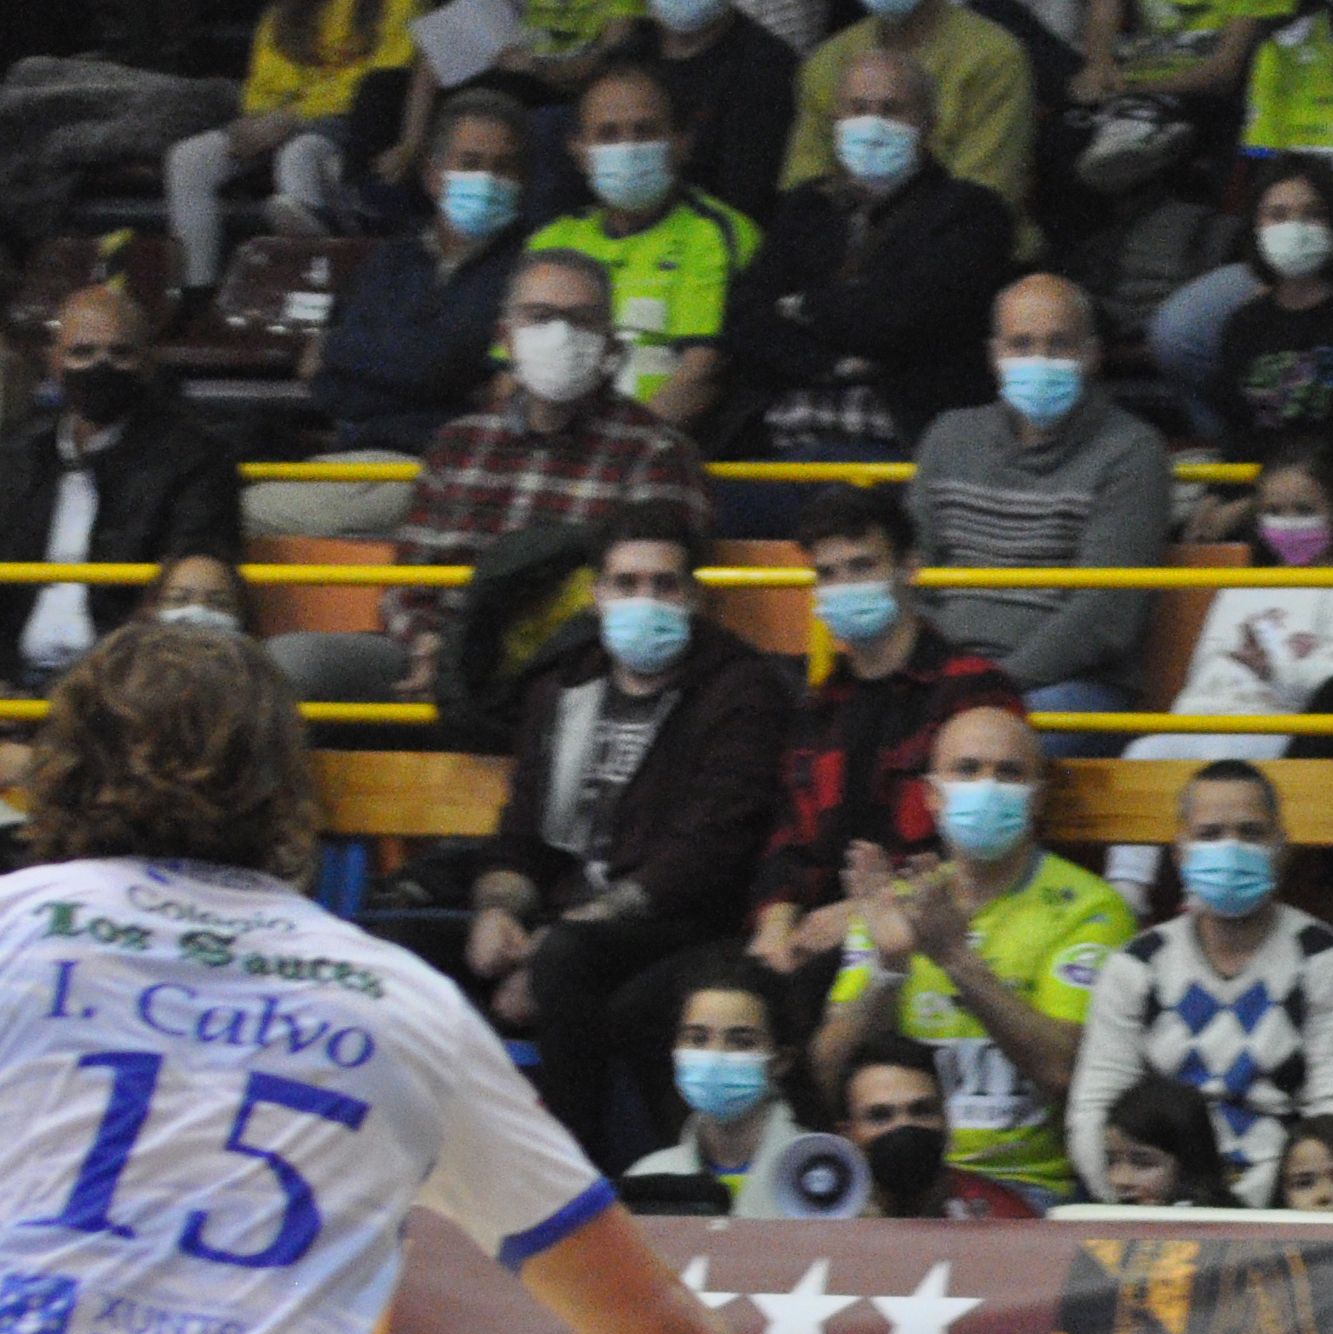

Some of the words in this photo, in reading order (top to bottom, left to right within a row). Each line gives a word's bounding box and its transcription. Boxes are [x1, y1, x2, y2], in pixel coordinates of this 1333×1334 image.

[45, 959, 97, 1020] I.
[137, 981, 377, 1069] Calvo
[14, 1050, 371, 1270] 15
